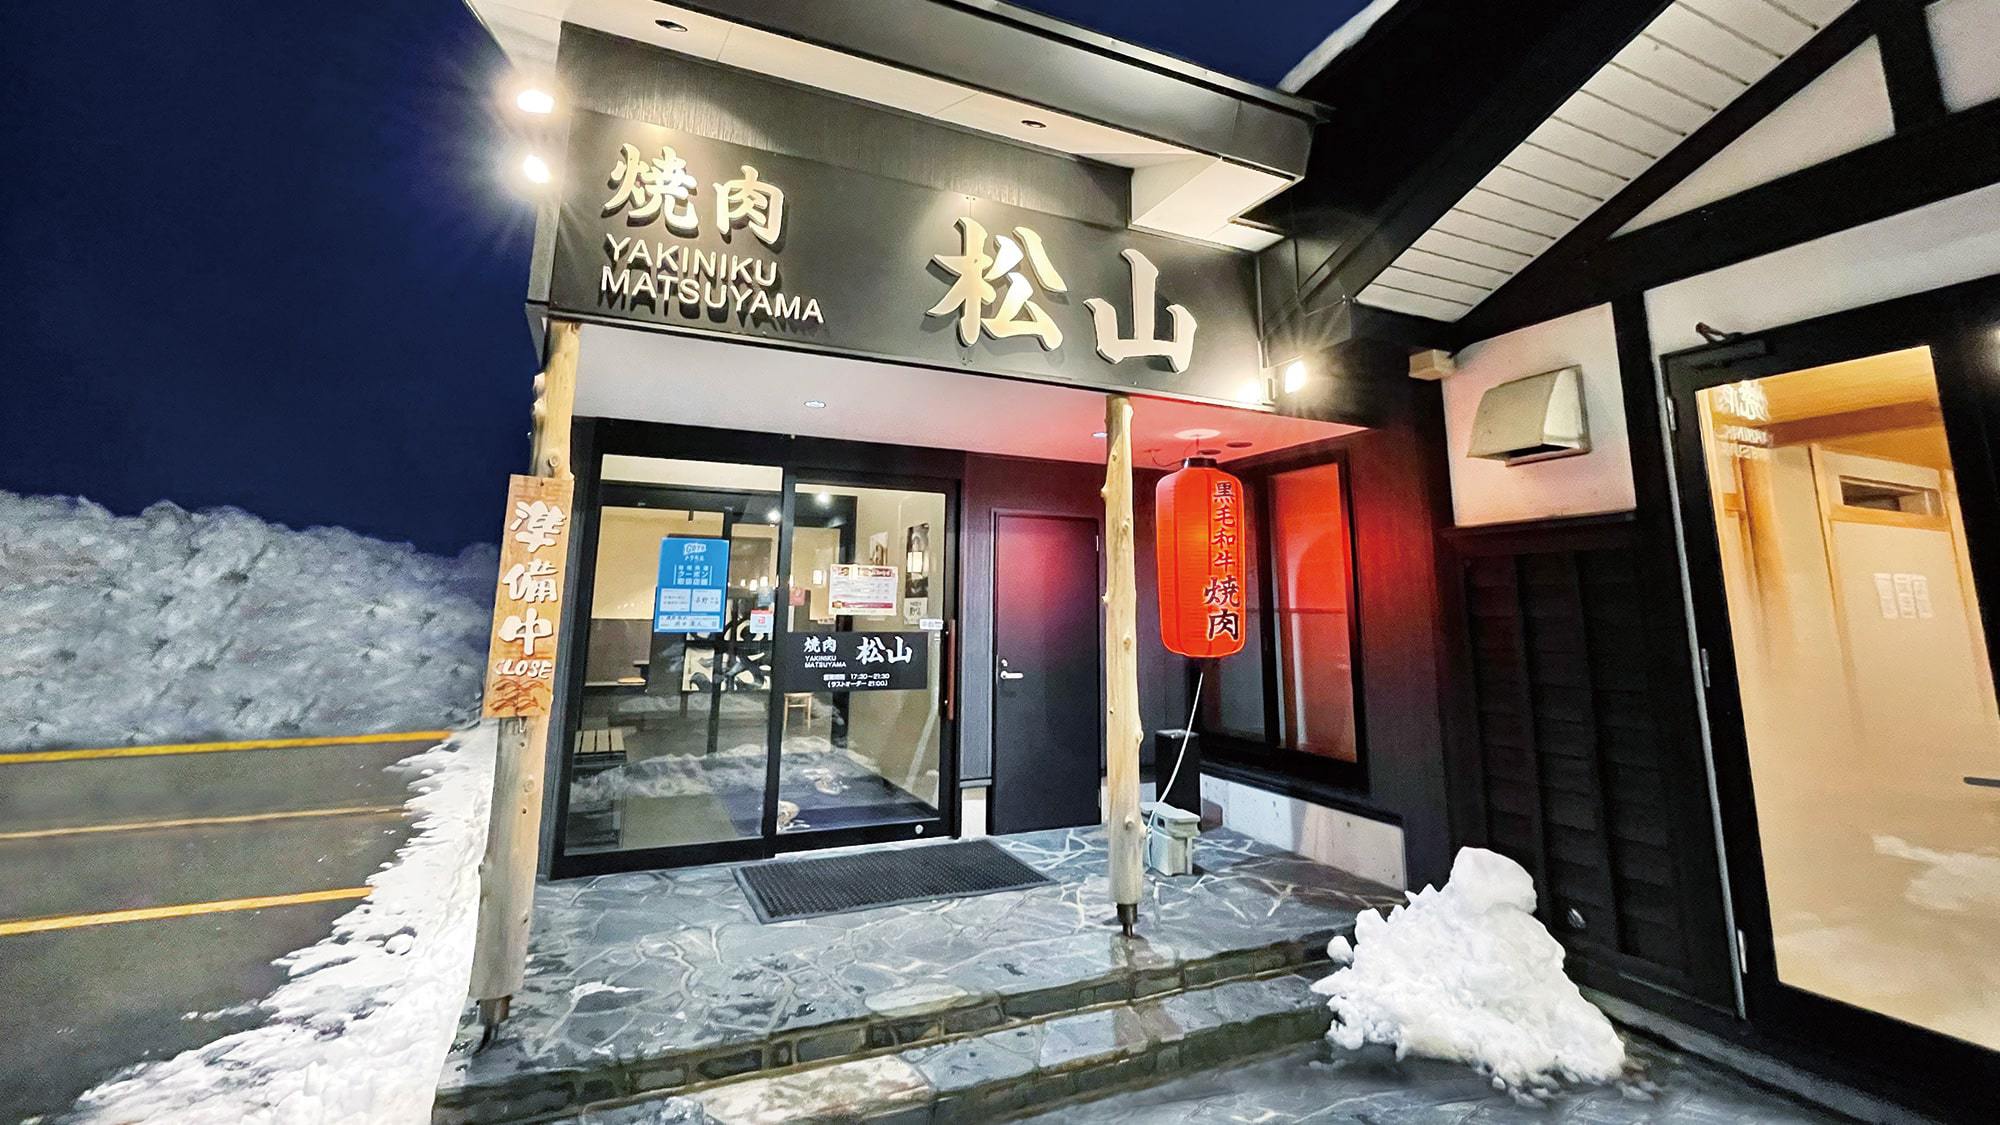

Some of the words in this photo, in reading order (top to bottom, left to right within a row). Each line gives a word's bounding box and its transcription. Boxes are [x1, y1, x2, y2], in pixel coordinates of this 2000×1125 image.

[603, 143, 785, 245] 焼肉
[606, 233, 778, 287] YAKINIKU
[601, 265, 824, 324] MATSUYAMA
[925, 217, 1198, 375] 松山
[498, 500, 567, 657] 準備中
[494, 659, 553, 680] CLOSE
[803, 635, 837, 653] 焼肉
[804, 661, 847, 669] MATSUYAMA
[855, 635, 913, 665] 松山
